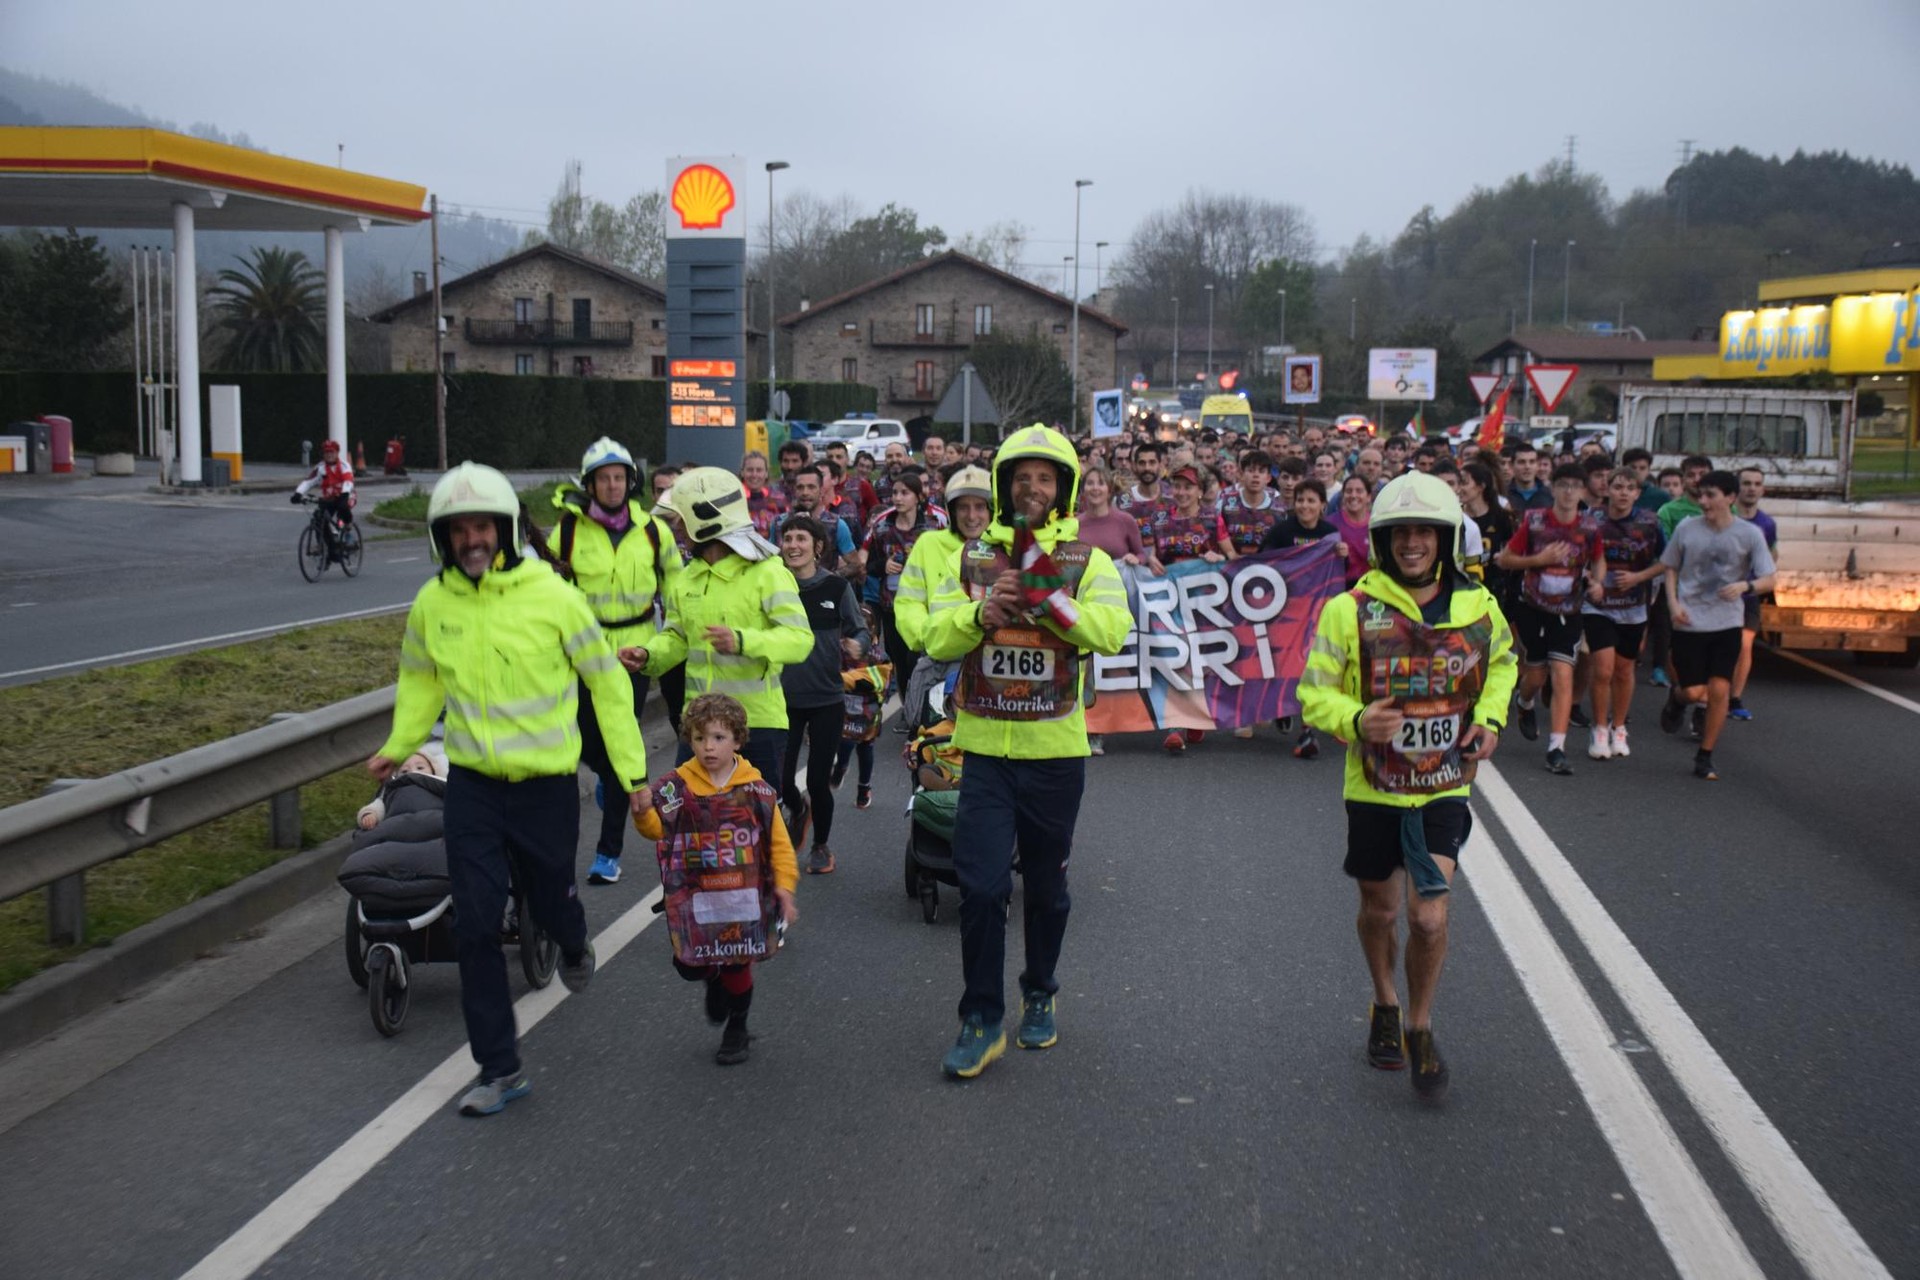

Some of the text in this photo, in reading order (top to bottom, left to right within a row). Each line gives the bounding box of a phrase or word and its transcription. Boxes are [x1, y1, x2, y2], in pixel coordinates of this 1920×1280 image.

[1138, 564, 1288, 634] RRO
[992, 650, 1045, 676] 2168
[843, 720, 863, 733] rika
[1402, 718, 1453, 748] 2168
